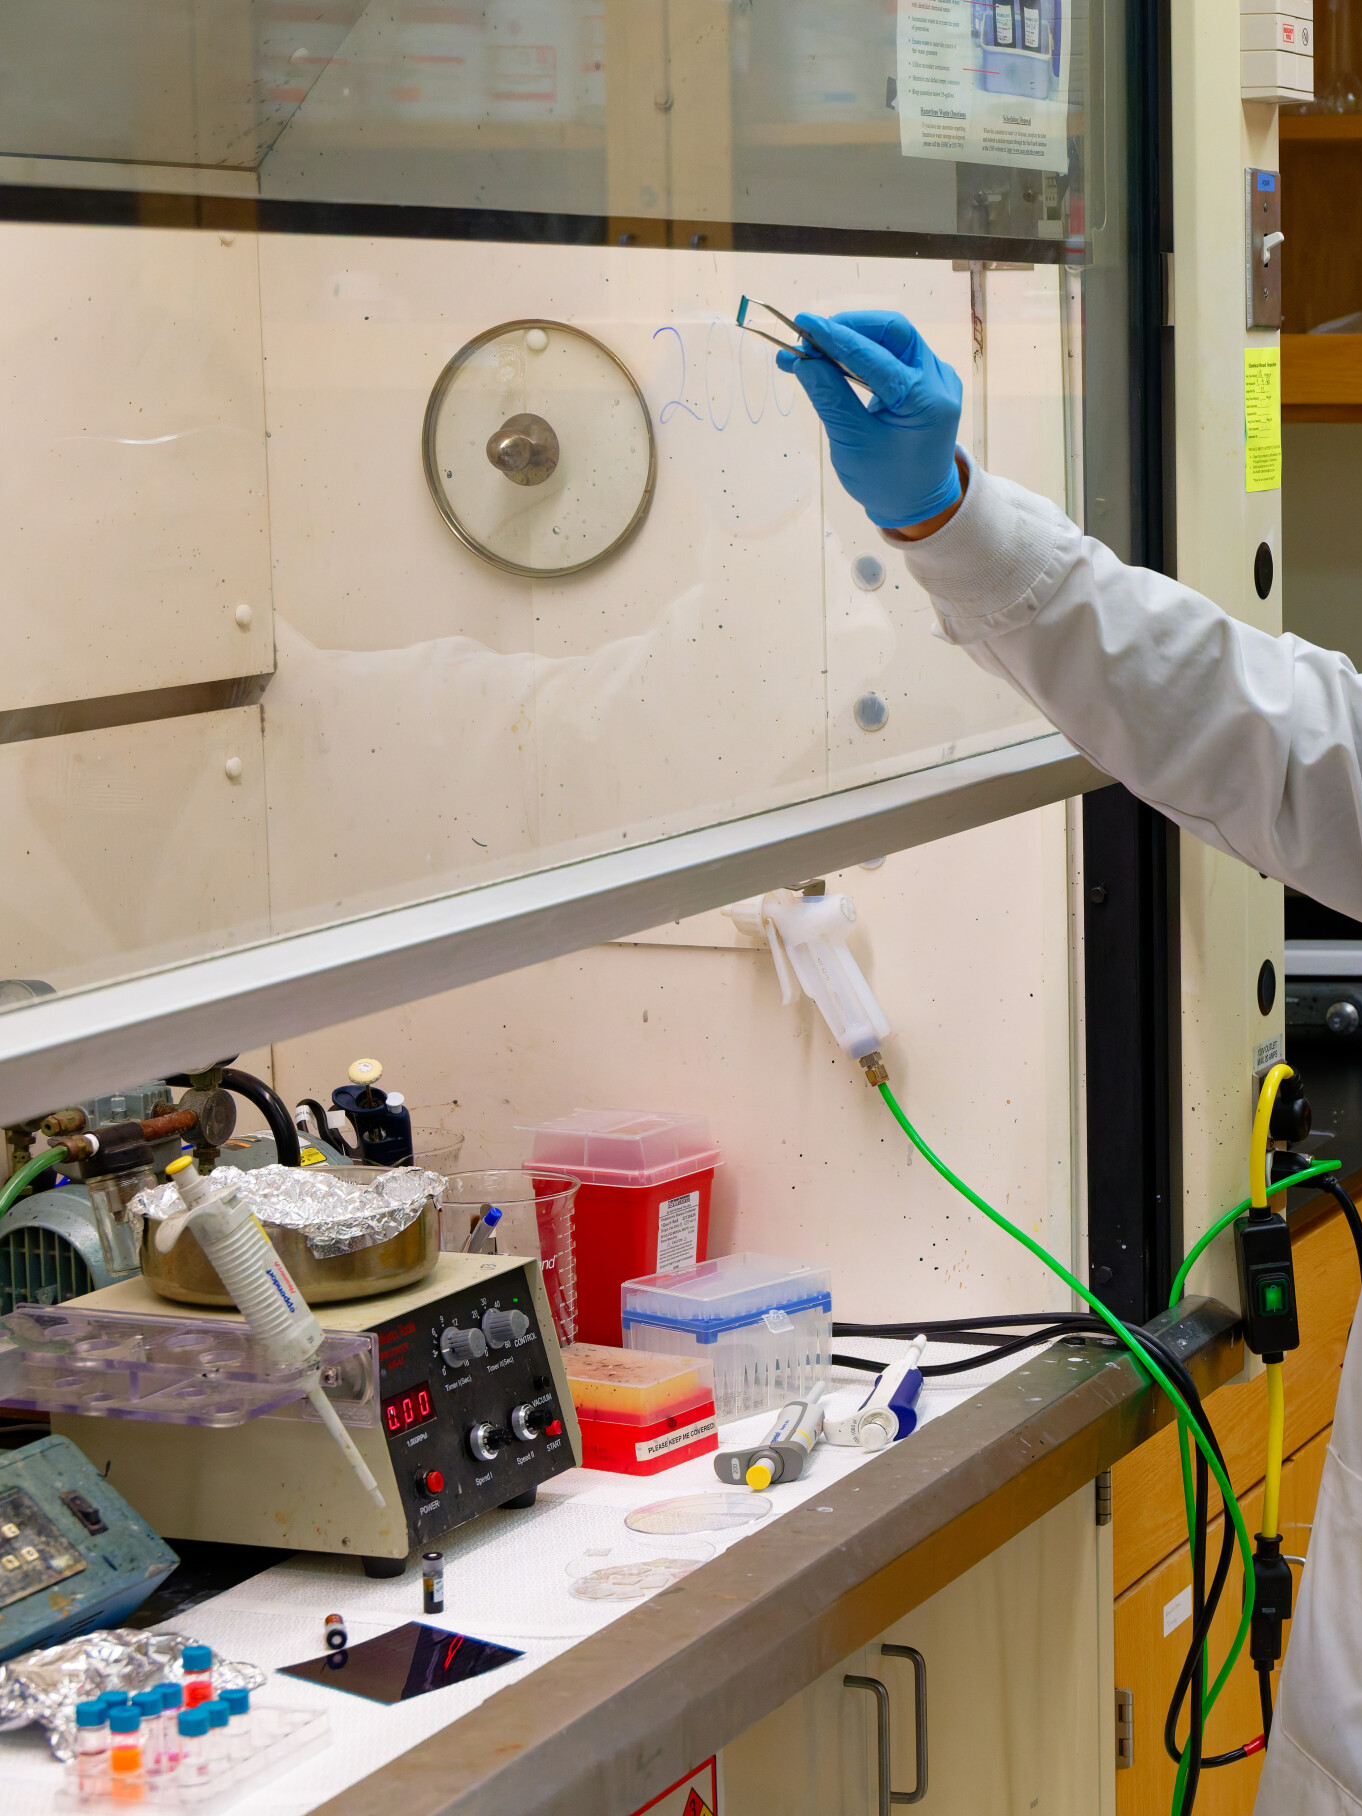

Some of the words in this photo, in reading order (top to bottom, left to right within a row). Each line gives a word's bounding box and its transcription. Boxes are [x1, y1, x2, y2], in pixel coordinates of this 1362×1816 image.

[266, 1269, 295, 1313] eppendorf
[471, 1310, 478, 1319] 20
[452, 1318, 458, 1327] 12
[514, 1332, 537, 1348] CONTROL
[486, 1363, 500, 1373] Timer
[445, 1382, 458, 1392] Timer
[531, 1393, 553, 1408] VACUUM
[546, 1439, 562, 1452] START
[648, 1440, 668, 1454] PLEASE
[668, 1435, 682, 1447] KEEP
[682, 1432, 690, 1440] ME
[516, 1453, 531, 1466] Speed
[475, 1474, 490, 1486] Speed
[419, 1499, 440, 1516] POWER
